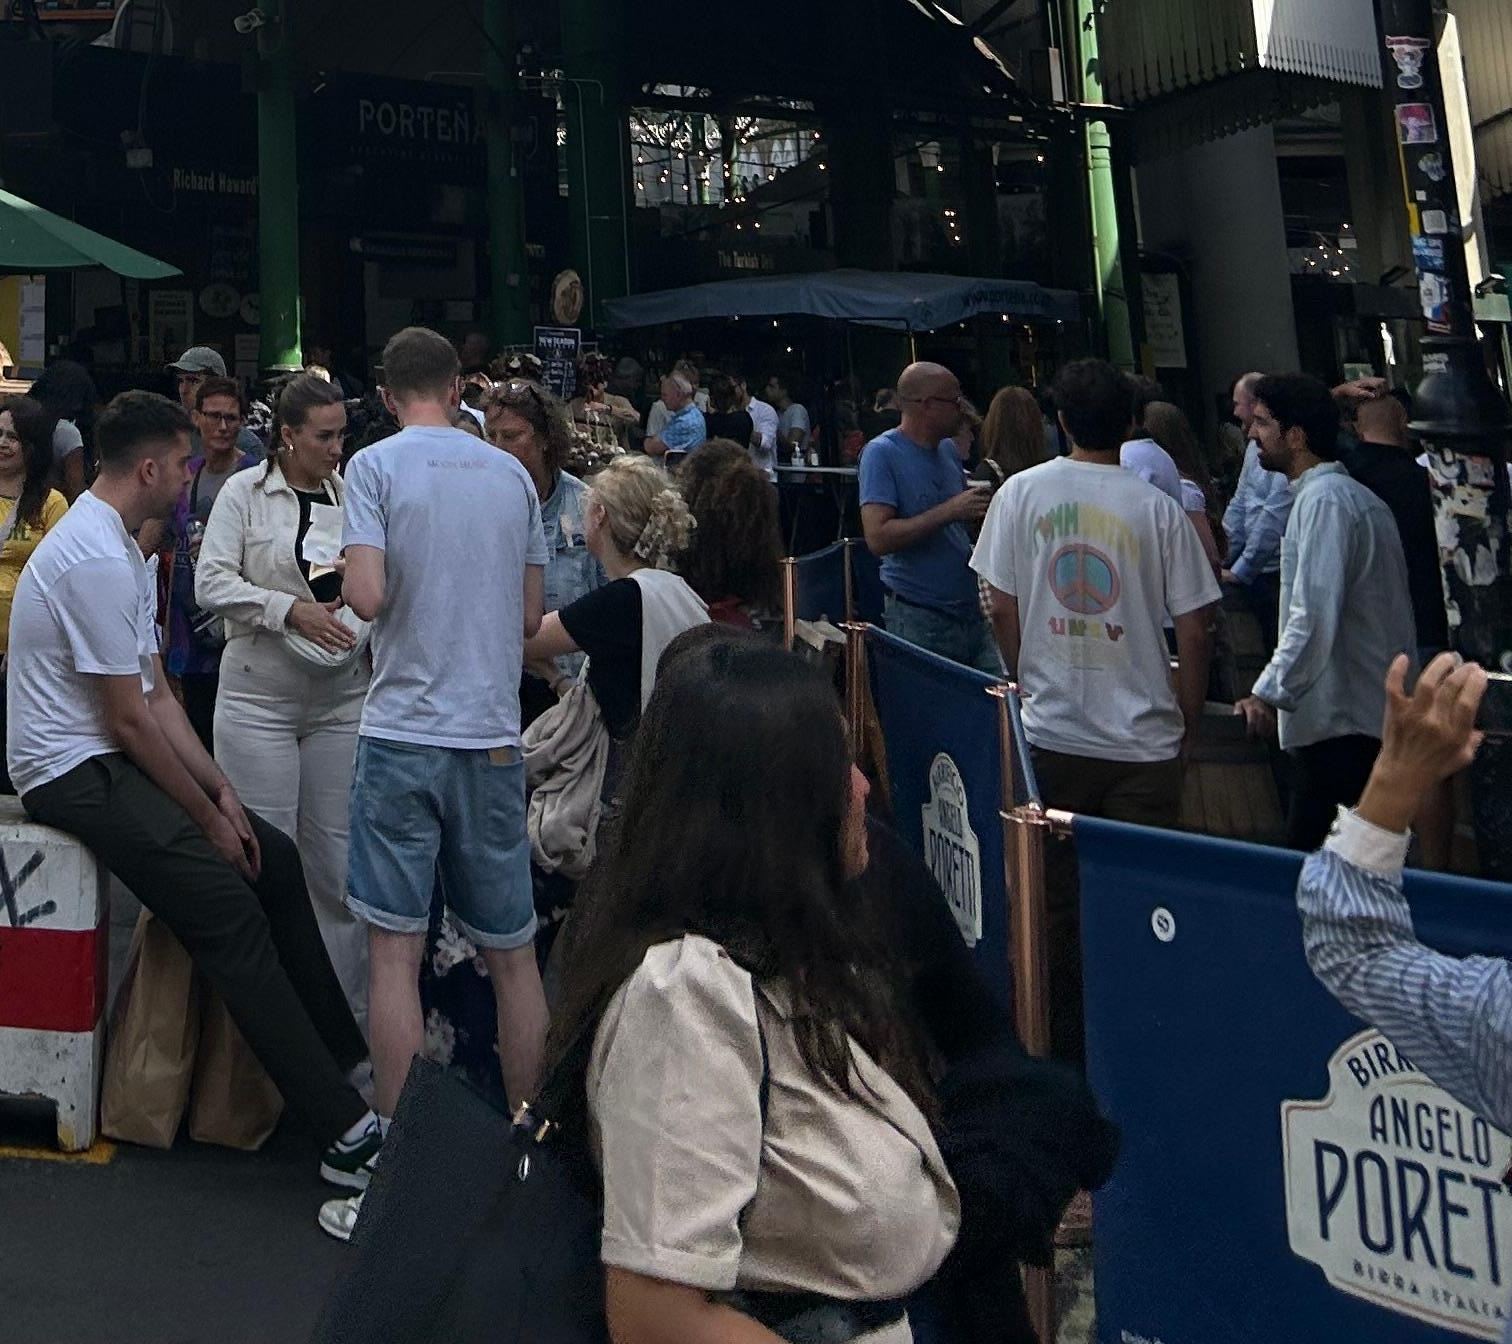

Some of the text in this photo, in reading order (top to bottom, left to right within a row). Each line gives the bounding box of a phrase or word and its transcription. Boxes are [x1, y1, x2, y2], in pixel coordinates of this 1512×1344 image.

[173, 167, 215, 192] Richard
[1369, 1093, 1493, 1168] ANGELO
[1314, 1138, 1512, 1287] PORET
[1431, 1285, 1505, 1319] ITALIA
